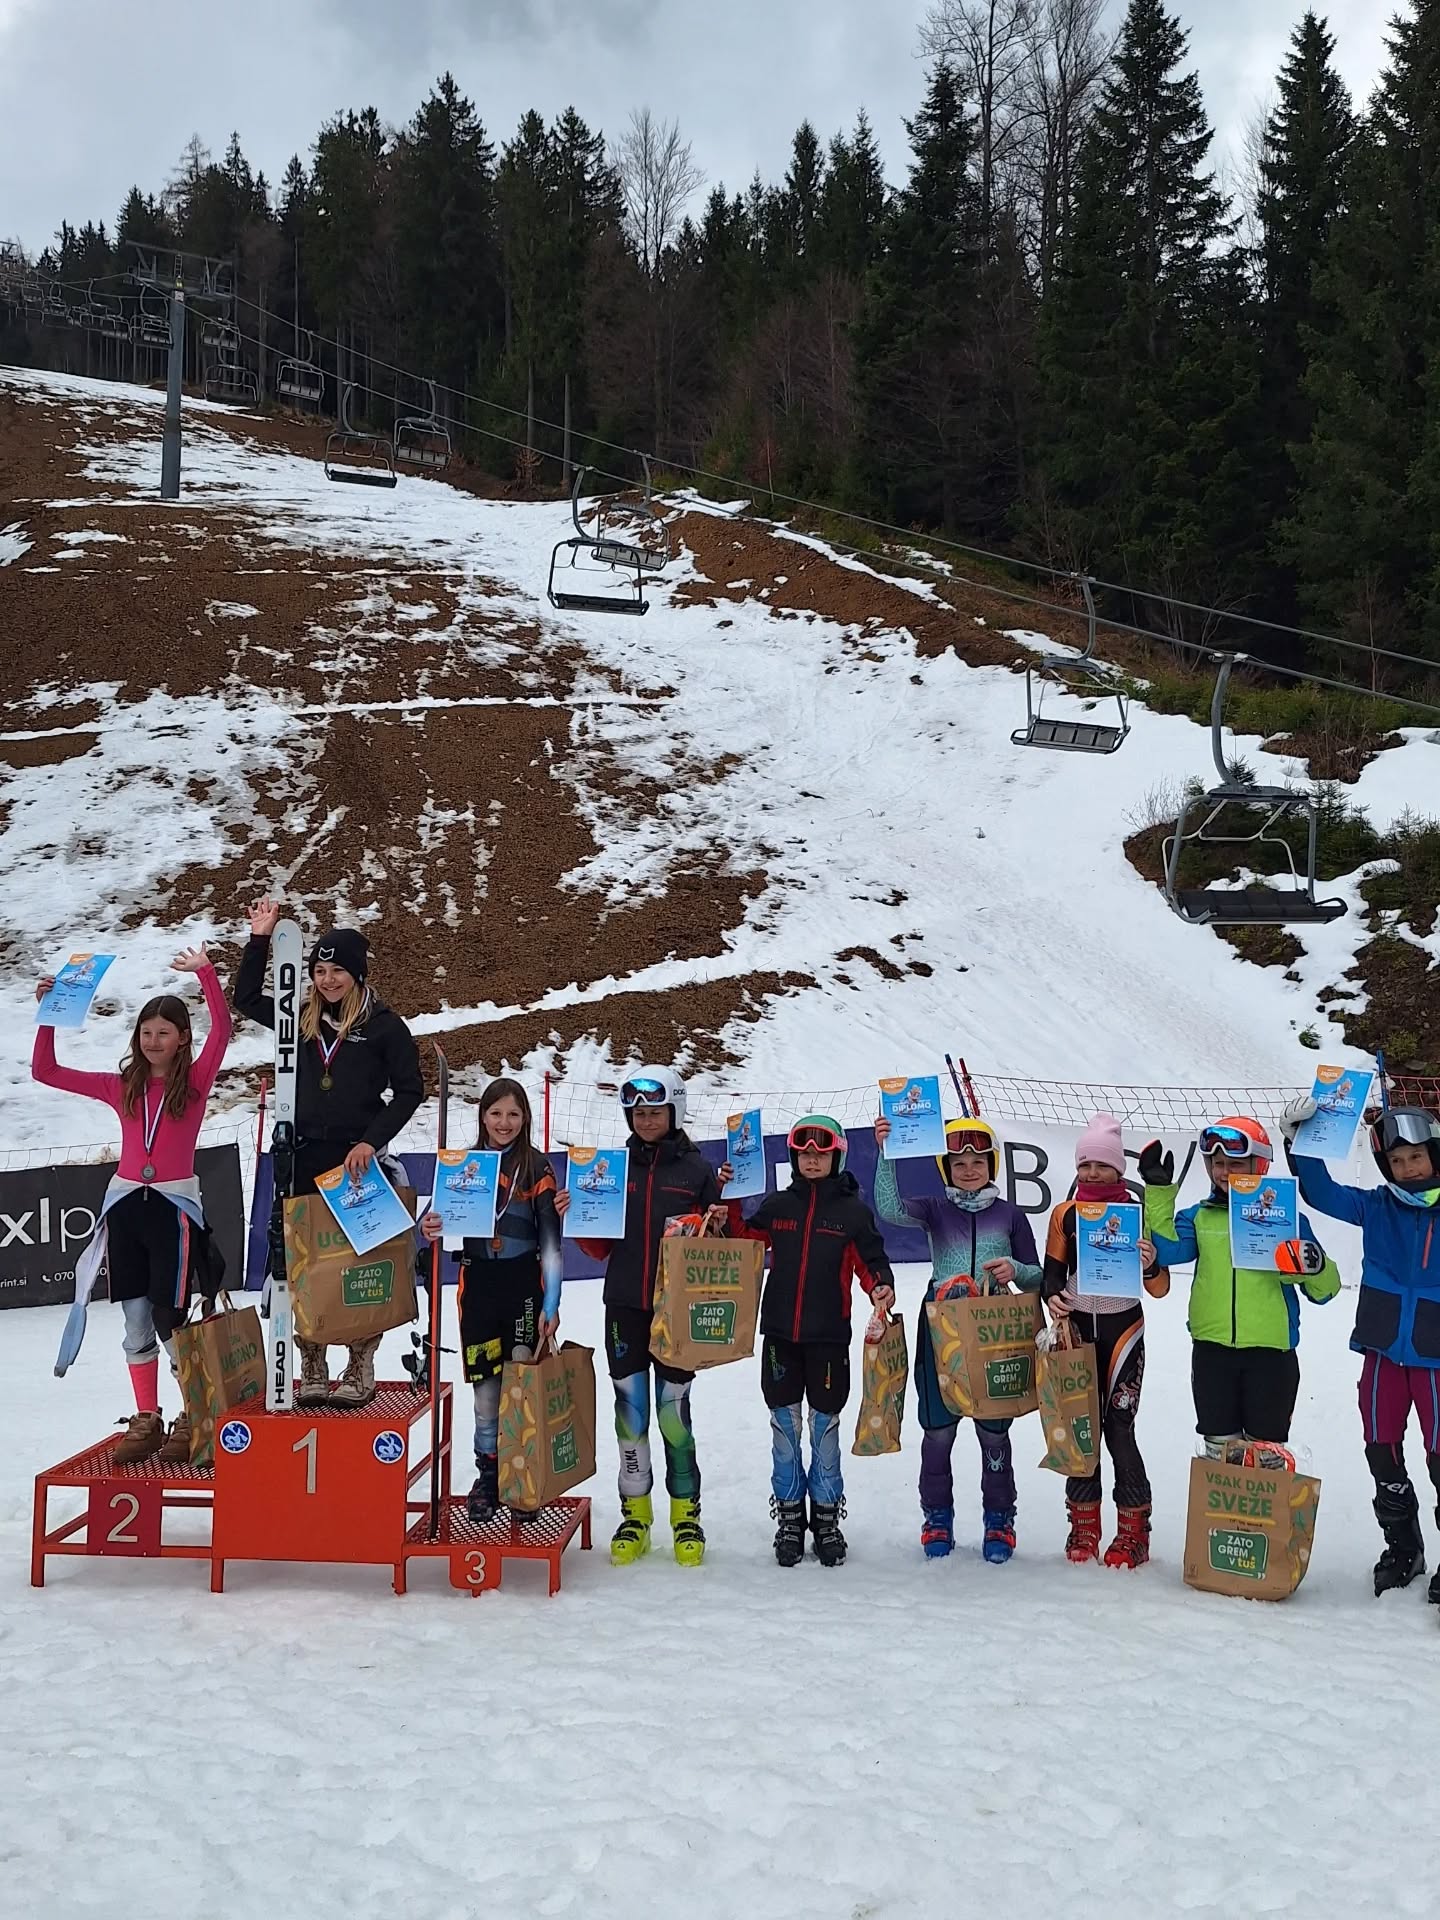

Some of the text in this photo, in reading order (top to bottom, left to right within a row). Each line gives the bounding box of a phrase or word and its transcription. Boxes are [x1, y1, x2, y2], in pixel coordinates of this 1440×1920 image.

[278, 962, 295, 1073] HEAD
[892, 1101, 931, 1112] DIPLOMO
[1317, 1097, 1355, 1108] DIPLOMO
[732, 1138, 756, 1150] DIPLOMO
[446, 1178, 486, 1186] DIPLOMO
[577, 1177, 616, 1186] DIPLOMO
[340, 1183, 378, 1206] DIPLOMO
[1241, 1207, 1286, 1217] DIPLOMO
[1088, 1234, 1130, 1243] DIPLOMO
[683, 1248, 742, 1261] VSAK DAN
[54, 1271, 74, 1283] 070
[358, 1268, 382, 1279] ZATO
[686, 1261, 740, 1284] SVEŽE
[350, 1279, 377, 1290] GREM
[702, 1306, 725, 1316] ZATO
[971, 1305, 1035, 1320] VSAK DAN
[525, 1297, 534, 1343] SLOVENIA
[696, 1317, 720, 1327] GREM
[977, 1318, 1033, 1343] SVEŽE
[274, 1340, 286, 1404] HEAD
[1000, 1363, 1020, 1373] ZATO
[993, 1373, 1017, 1383] GREM
[292, 1427, 317, 1494] 1
[1205, 1471, 1277, 1494] VSAK DAN
[1208, 1490, 1272, 1517] SVEŽE
[106, 1492, 140, 1543] 2
[1227, 1535, 1254, 1548] ZATO
[1217, 1544, 1249, 1558] GREM
[464, 1550, 486, 1584] 3
